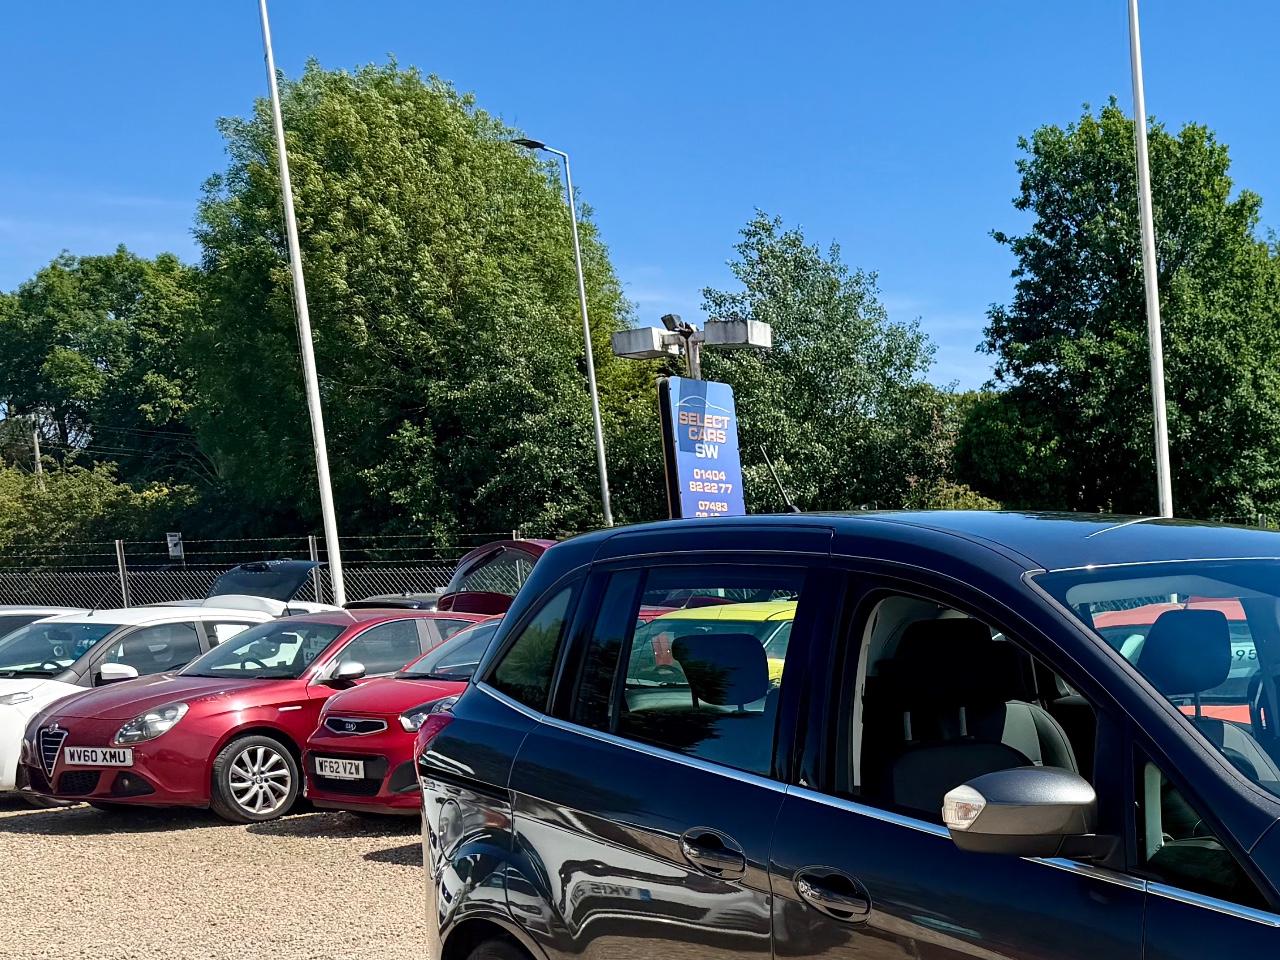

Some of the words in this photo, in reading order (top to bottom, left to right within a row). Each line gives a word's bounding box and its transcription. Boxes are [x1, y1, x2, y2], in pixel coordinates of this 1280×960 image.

[680, 411, 730, 429] SELECT
[688, 427, 726, 443] CARS
[695, 443, 719, 459] SW
[693, 468, 726, 481] 01404
[1231, 649, 1257, 660] 95
[69, 749, 98, 763] WV60
[101, 750, 126, 763] XMU
[318, 759, 340, 774] WF62
[342, 762, 360, 775] VZW
